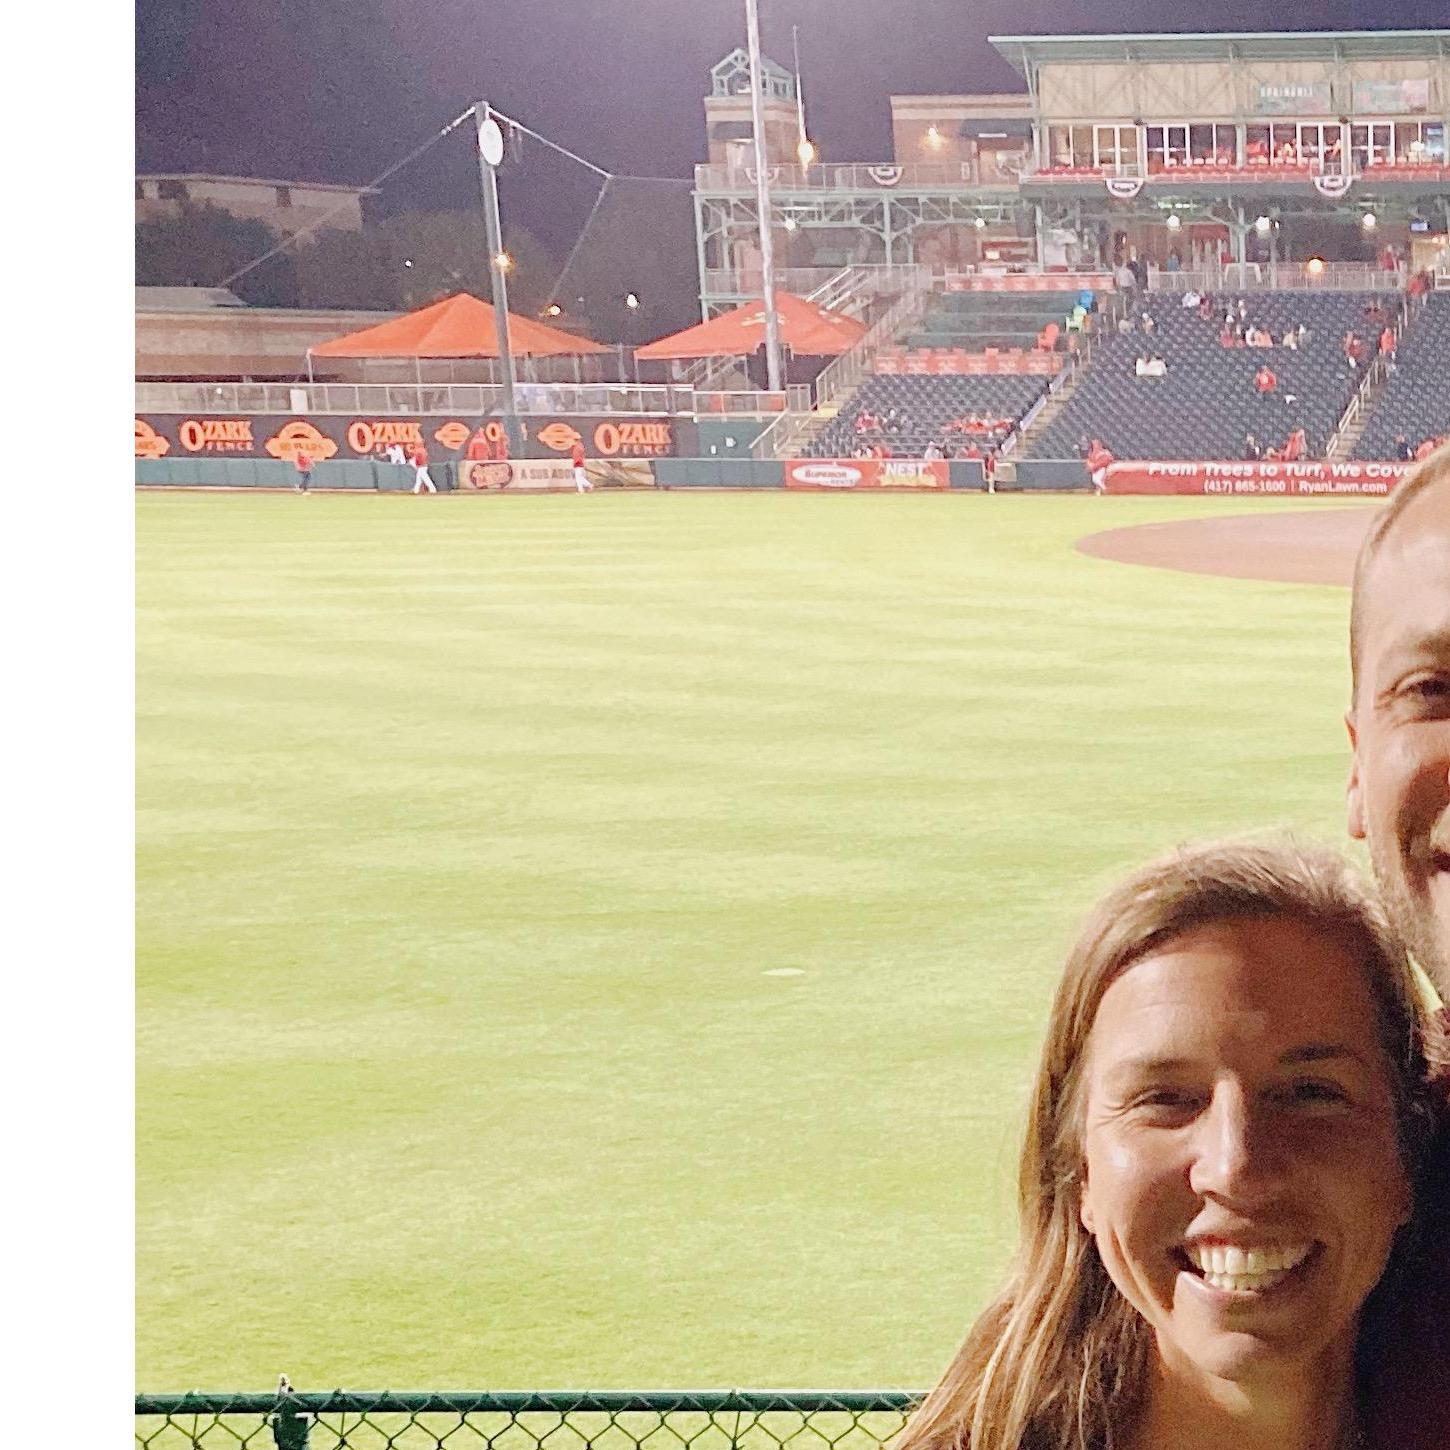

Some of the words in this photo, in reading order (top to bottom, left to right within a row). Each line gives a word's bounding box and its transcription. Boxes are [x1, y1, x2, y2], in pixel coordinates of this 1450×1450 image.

[180, 420, 253, 451] OZARK
[348, 422, 424, 453] OZARK
[594, 423, 672, 455] OZARK
[207, 442, 254, 451] FENCE
[622, 444, 671, 455] FENCE
[520, 468, 528, 479] A
[530, 468, 549, 479] SUB
[1148, 463, 1197, 476] From
[1203, 463, 1253, 476] Trees
[1259, 464, 1278, 477] to
[1285, 463, 1326, 480] Turf,
[1331, 464, 1360, 477] We
[1204, 480, 1232, 494] (417)
[1300, 480, 1388, 494] RyanLawn.com
